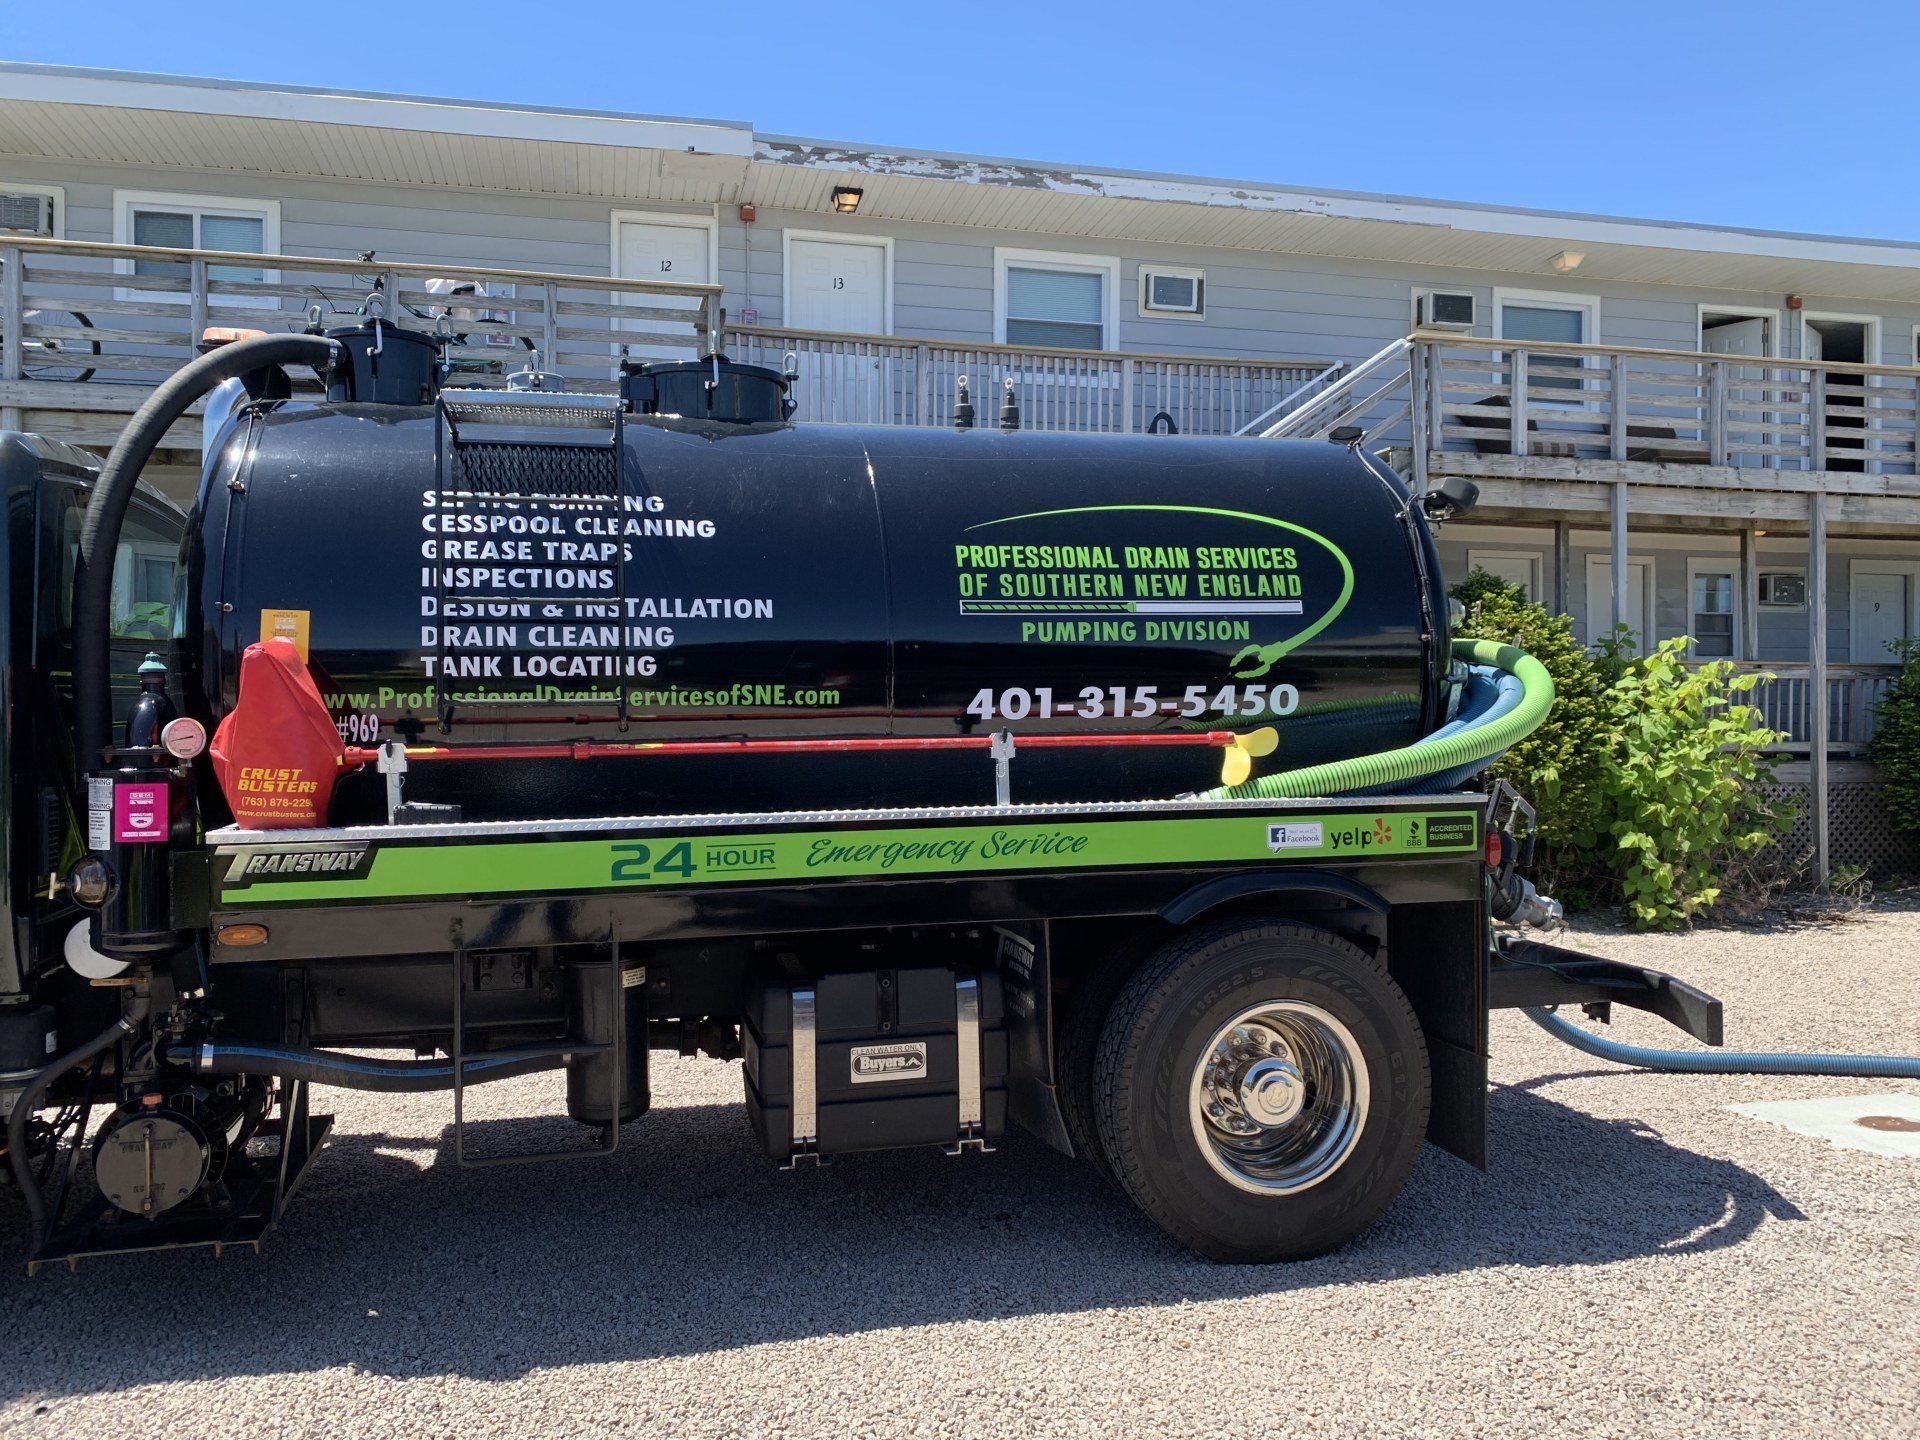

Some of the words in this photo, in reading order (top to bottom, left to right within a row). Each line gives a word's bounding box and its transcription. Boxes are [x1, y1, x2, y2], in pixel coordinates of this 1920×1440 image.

[660, 260, 672, 272] 12
[833, 277, 844, 290] 13
[422, 514, 566, 535] CESSPOOL
[575, 517, 716, 538] CLEANING
[421, 540, 533, 560] GREASE
[542, 541, 633, 562] TRAPS
[955, 544, 1119, 569] PROFESSIONAL
[1125, 546, 1190, 569] DRAIN
[1197, 546, 1298, 569] SERVICES
[421, 567, 614, 589] INSPECTIONS
[959, 573, 988, 597] OF
[1000, 572, 1125, 597] SOUTHERN
[1135, 573, 1188, 597] NEW
[1199, 573, 1302, 597] ENGLAND
[421, 596, 531, 617] DESIGN
[542, 601, 564, 618] &
[575, 597, 773, 619] INSTALLATION
[1874, 602, 1880, 613] 9
[421, 626, 517, 647] DRAIN
[528, 626, 675, 648] CLEANING
[1022, 621, 1137, 642] PUMPING
[1145, 620, 1250, 641] DIVISION
[420, 656, 503, 677] TANK
[512, 655, 658, 677] LOCATING
[966, 684, 1299, 720] 401-315-5450
[336, 714, 379, 742] #969
[240, 767, 303, 781] CRUST
[237, 778, 318, 793] BUSTERS
[241, 796, 267, 808] (763)
[1287, 834, 1320, 843] Facebook
[1330, 827, 1372, 849] yelp
[1429, 824, 1473, 832] ACCREDITED
[1429, 832, 1464, 841] BUSINESS
[1406, 839, 1422, 847] BBB
[214, 840, 370, 882] TRANSWAY
[610, 842, 698, 881] 24
[706, 848, 776, 867] HOUR
[806, 837, 975, 870] Emergency
[980, 830, 1089, 858] Service
[851, 1047, 876, 1056] CLEAN
[877, 1045, 903, 1054] WATER
[904, 1043, 924, 1052] ONLY
[860, 1056, 906, 1071] Buyers
